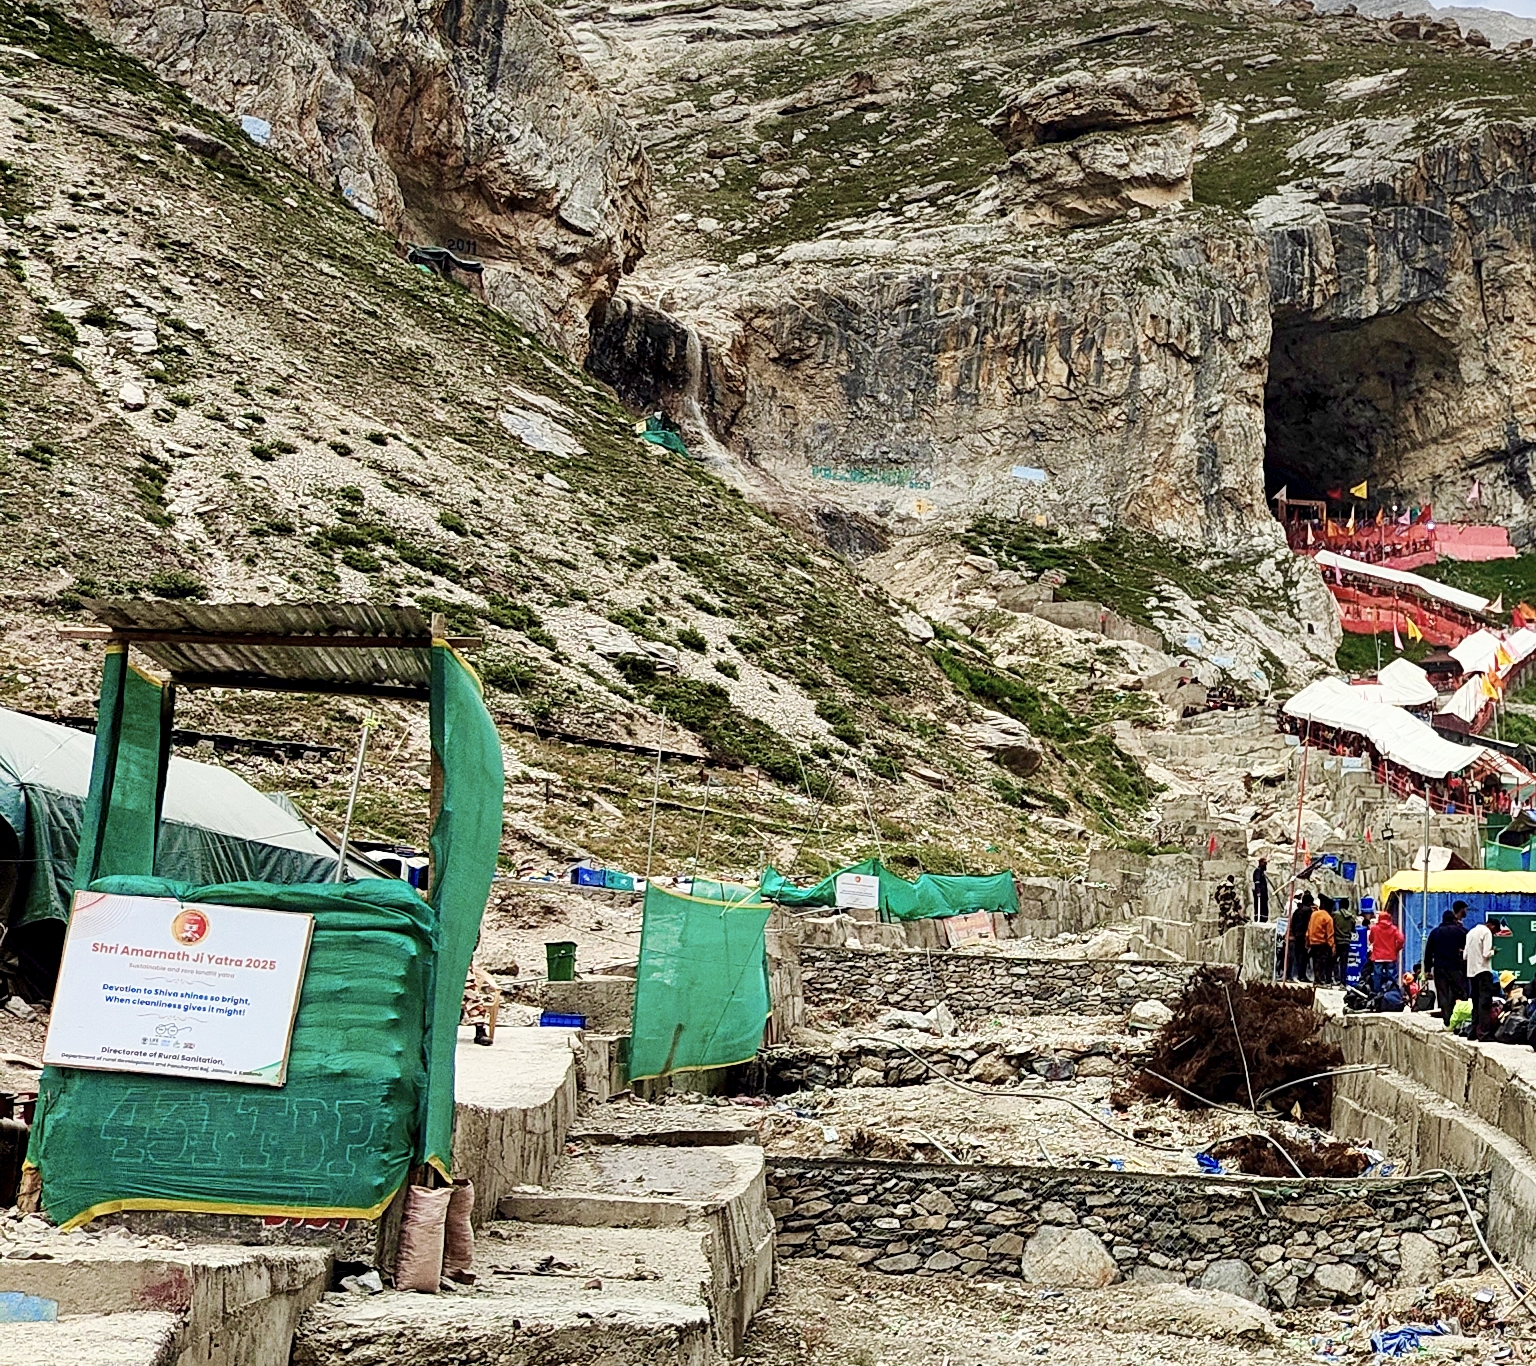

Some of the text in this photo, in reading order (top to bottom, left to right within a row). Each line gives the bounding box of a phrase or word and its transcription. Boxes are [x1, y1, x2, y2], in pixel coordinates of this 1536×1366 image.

[447, 238, 477, 255] 2011
[91, 942, 277, 971] Shri Amarnath Ji Yatra 2025
[1517, 943, 1522, 963] I
[129, 962, 166, 972] Sustainable
[167, 966, 180, 974] and
[102, 983, 250, 1006] Devotion to Shiva shines so bright,
[105, 995, 245, 1017] When cleanliness gives it might!
[101, 1046, 147, 1058] Directorate
[158, 1052, 180, 1061] Rural
[181, 1055, 225, 1066] Sanitation,
